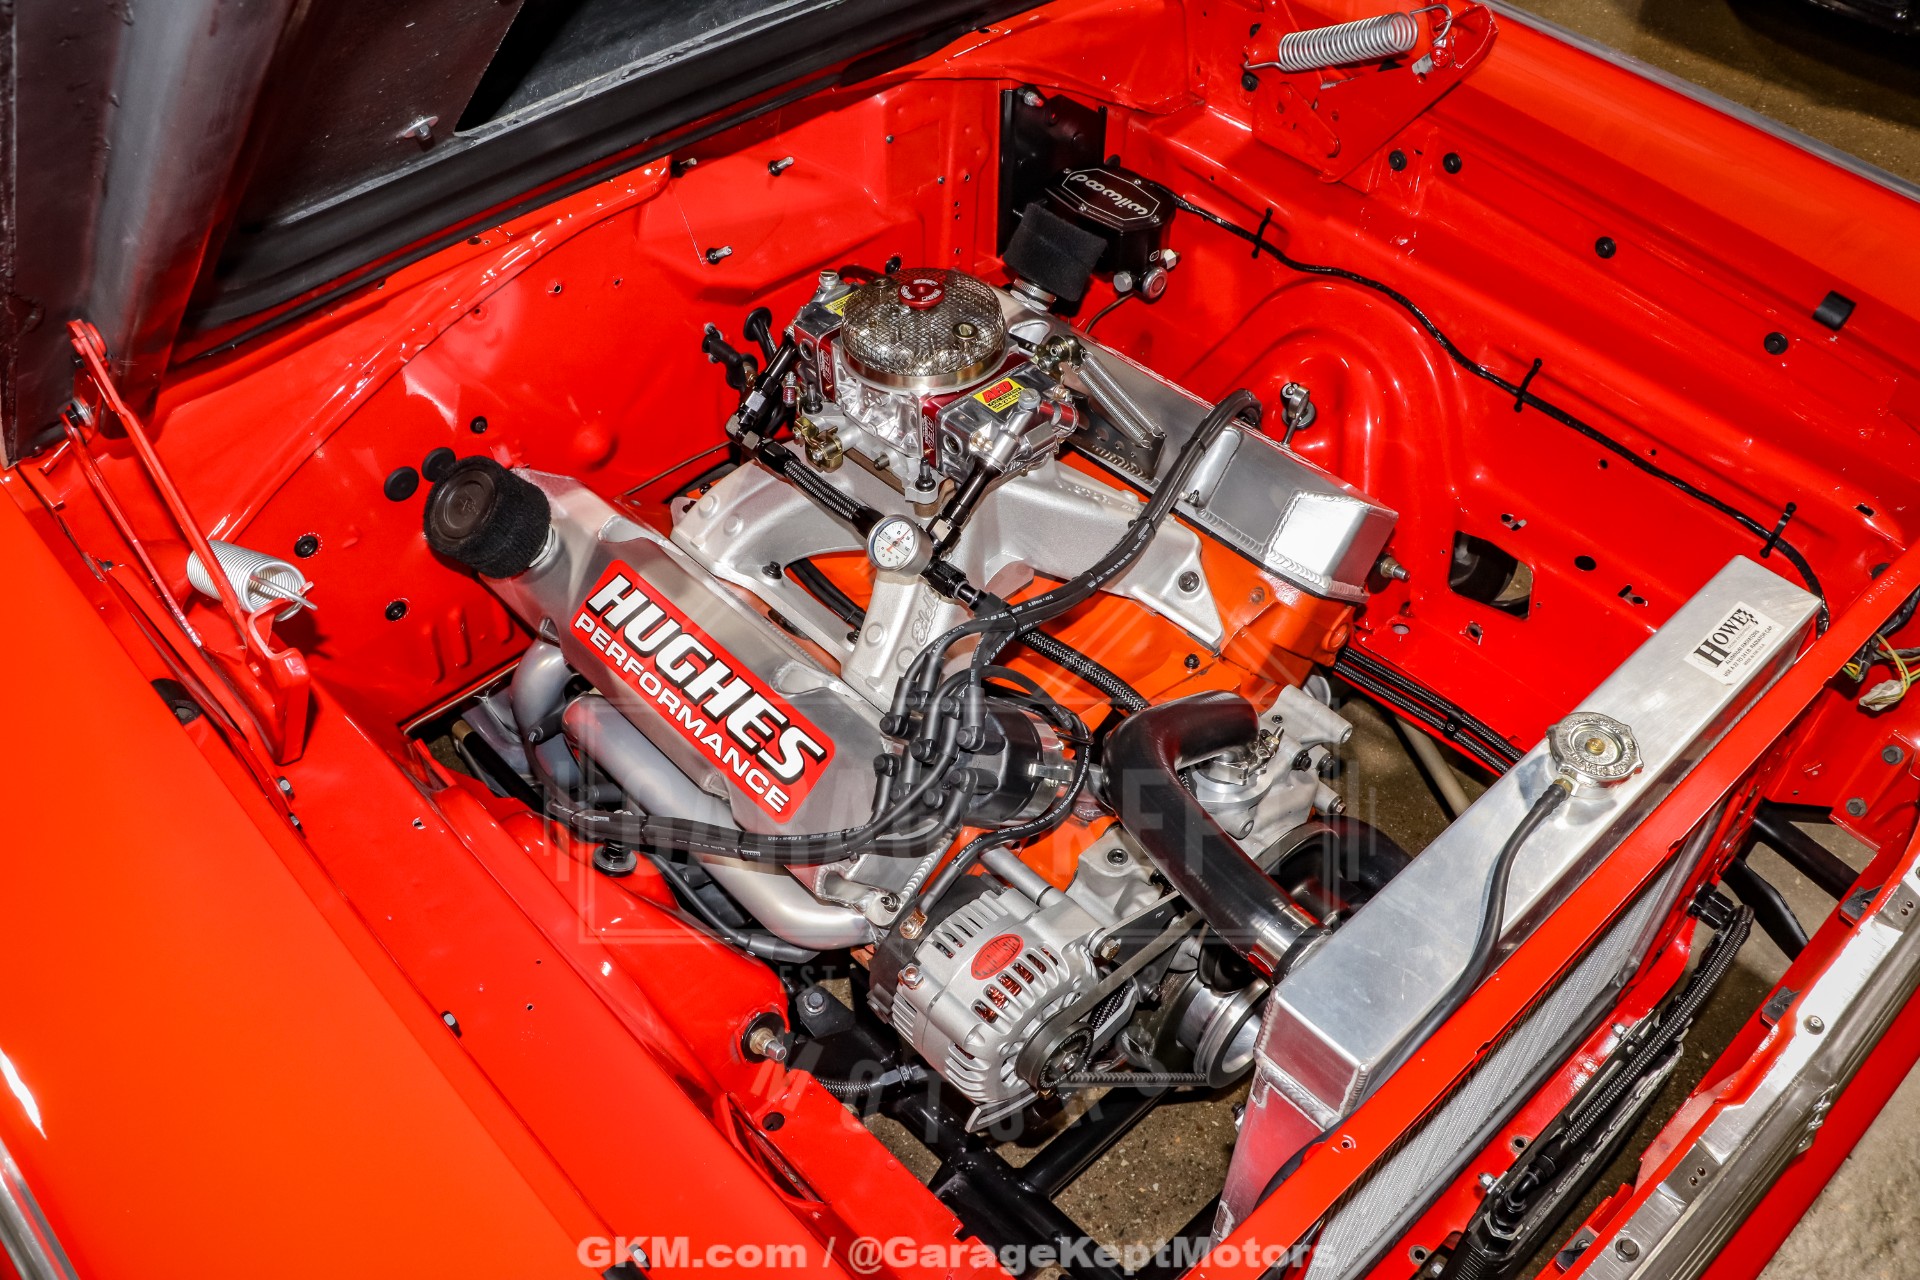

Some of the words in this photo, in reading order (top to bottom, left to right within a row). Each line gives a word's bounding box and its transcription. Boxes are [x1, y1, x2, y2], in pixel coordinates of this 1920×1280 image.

[1069, 174, 1148, 215] wilwood
[982, 380, 1013, 403] AED
[1693, 608, 1750, 668] HOWE
[586, 572, 828, 784] HUGHES
[574, 612, 790, 812] PERFORMANCE
